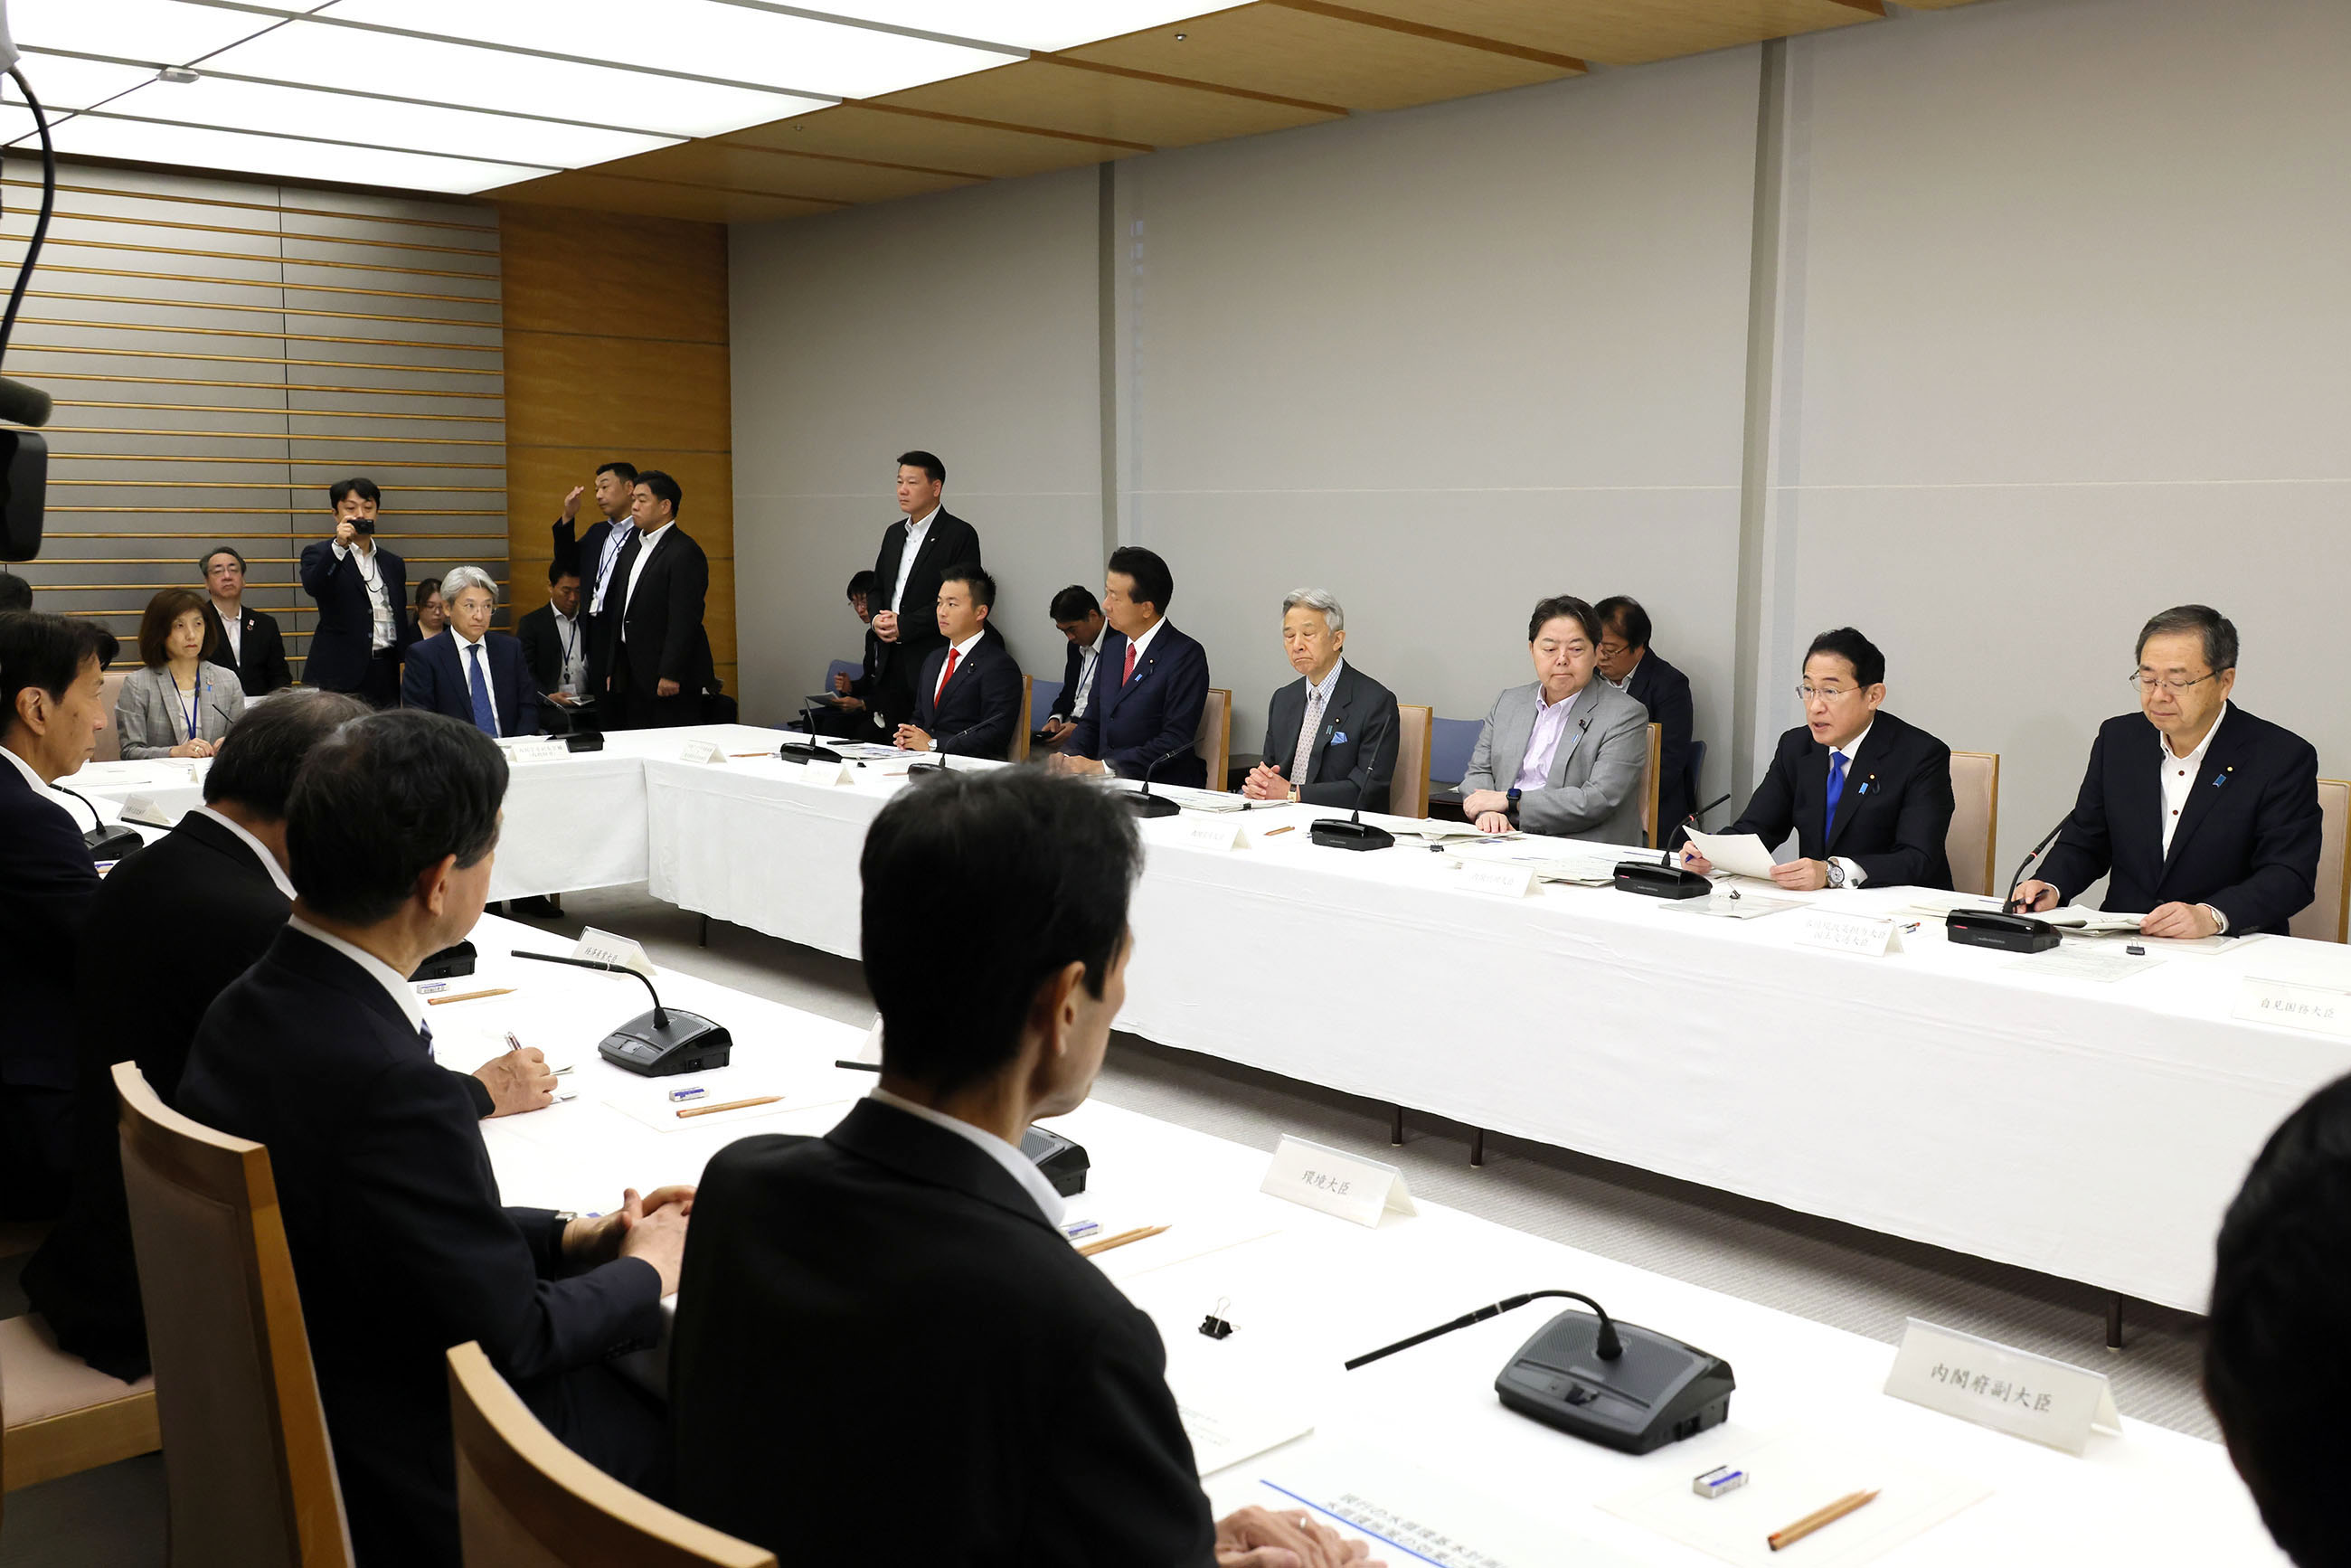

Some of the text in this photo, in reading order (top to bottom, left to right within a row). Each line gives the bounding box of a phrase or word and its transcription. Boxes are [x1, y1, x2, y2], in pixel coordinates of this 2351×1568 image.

[2261, 997, 2335, 1019] 自見国務大臣
[1301, 1170, 1350, 1195] 環境大臣
[1931, 1363, 2053, 1412] 内閣府副大臣
